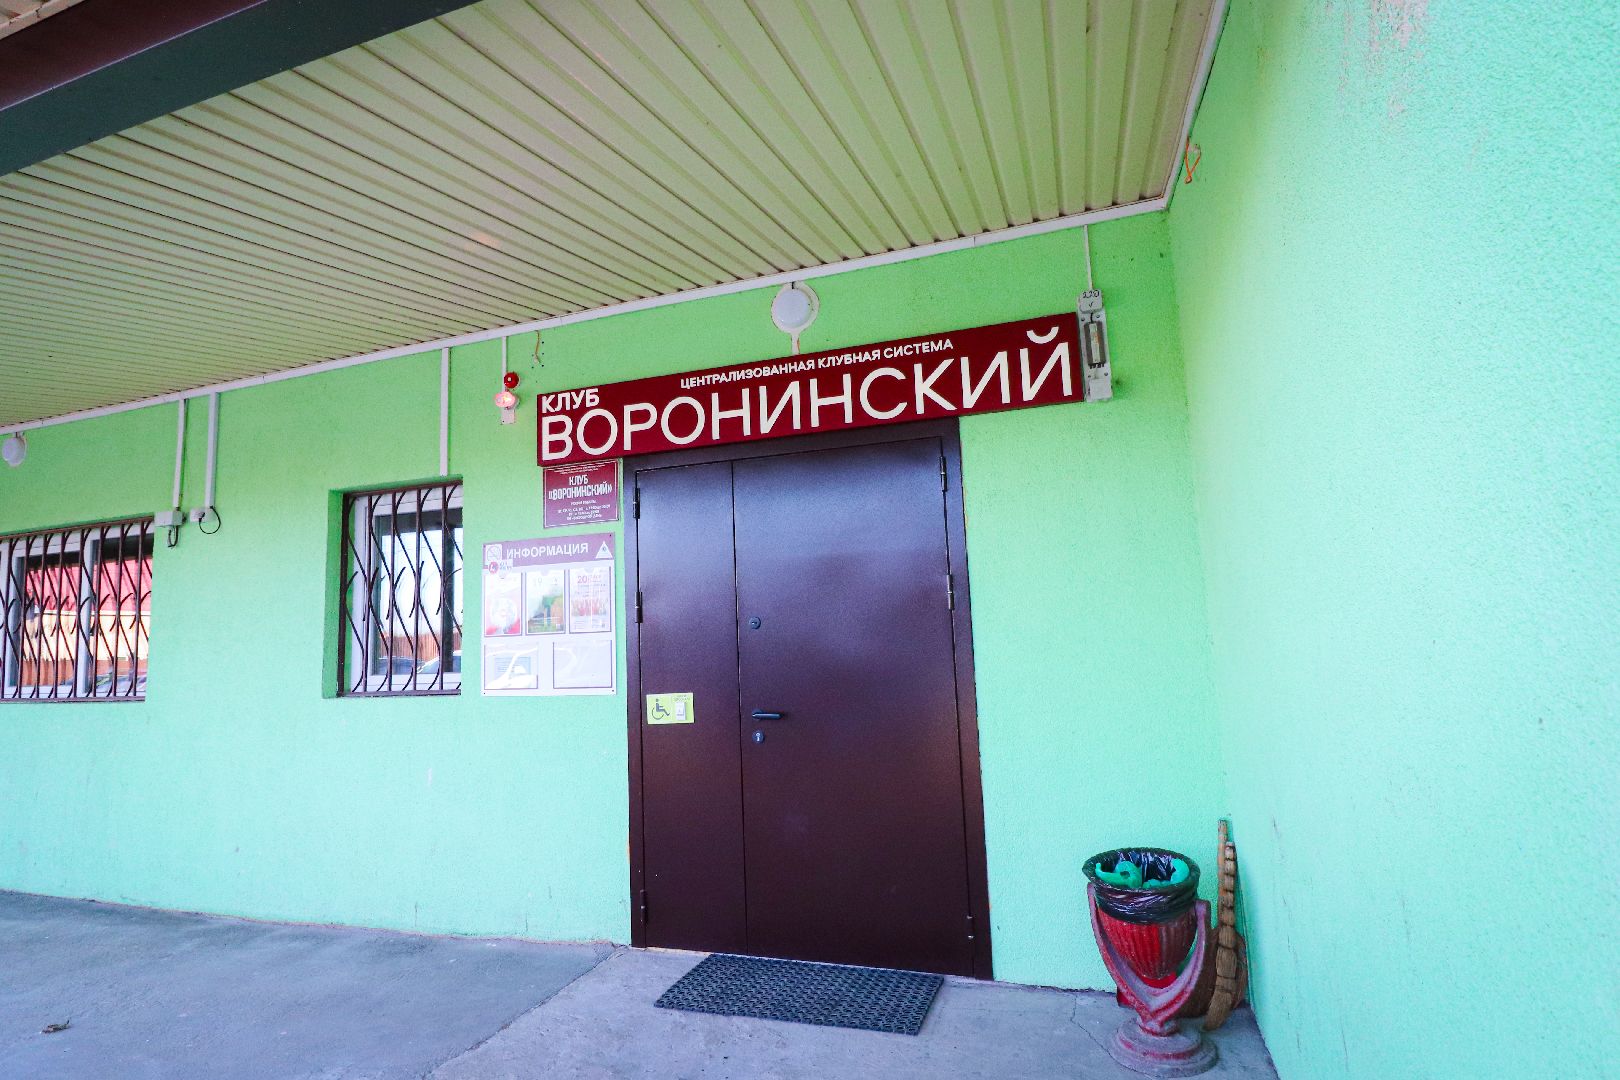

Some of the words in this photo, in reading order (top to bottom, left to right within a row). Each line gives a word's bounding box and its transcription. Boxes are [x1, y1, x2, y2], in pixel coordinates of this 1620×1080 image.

[680, 358, 815, 389] ЦЕНТРАЛИЗОВАННАЯ
[817, 349, 881, 369] КЛУБНАЯ
[883, 338, 954, 360] СИСТЕМА
[541, 326, 1073, 461] ВОРОНИНСКИЙ
[541, 388, 601, 414] КЛУБ
[548, 480, 613, 501] «ВОРОНИНСКИЙ»
[568, 474, 589, 486] КЛУБ
[506, 542, 589, 559] ИНФОРМАЦИЯ
